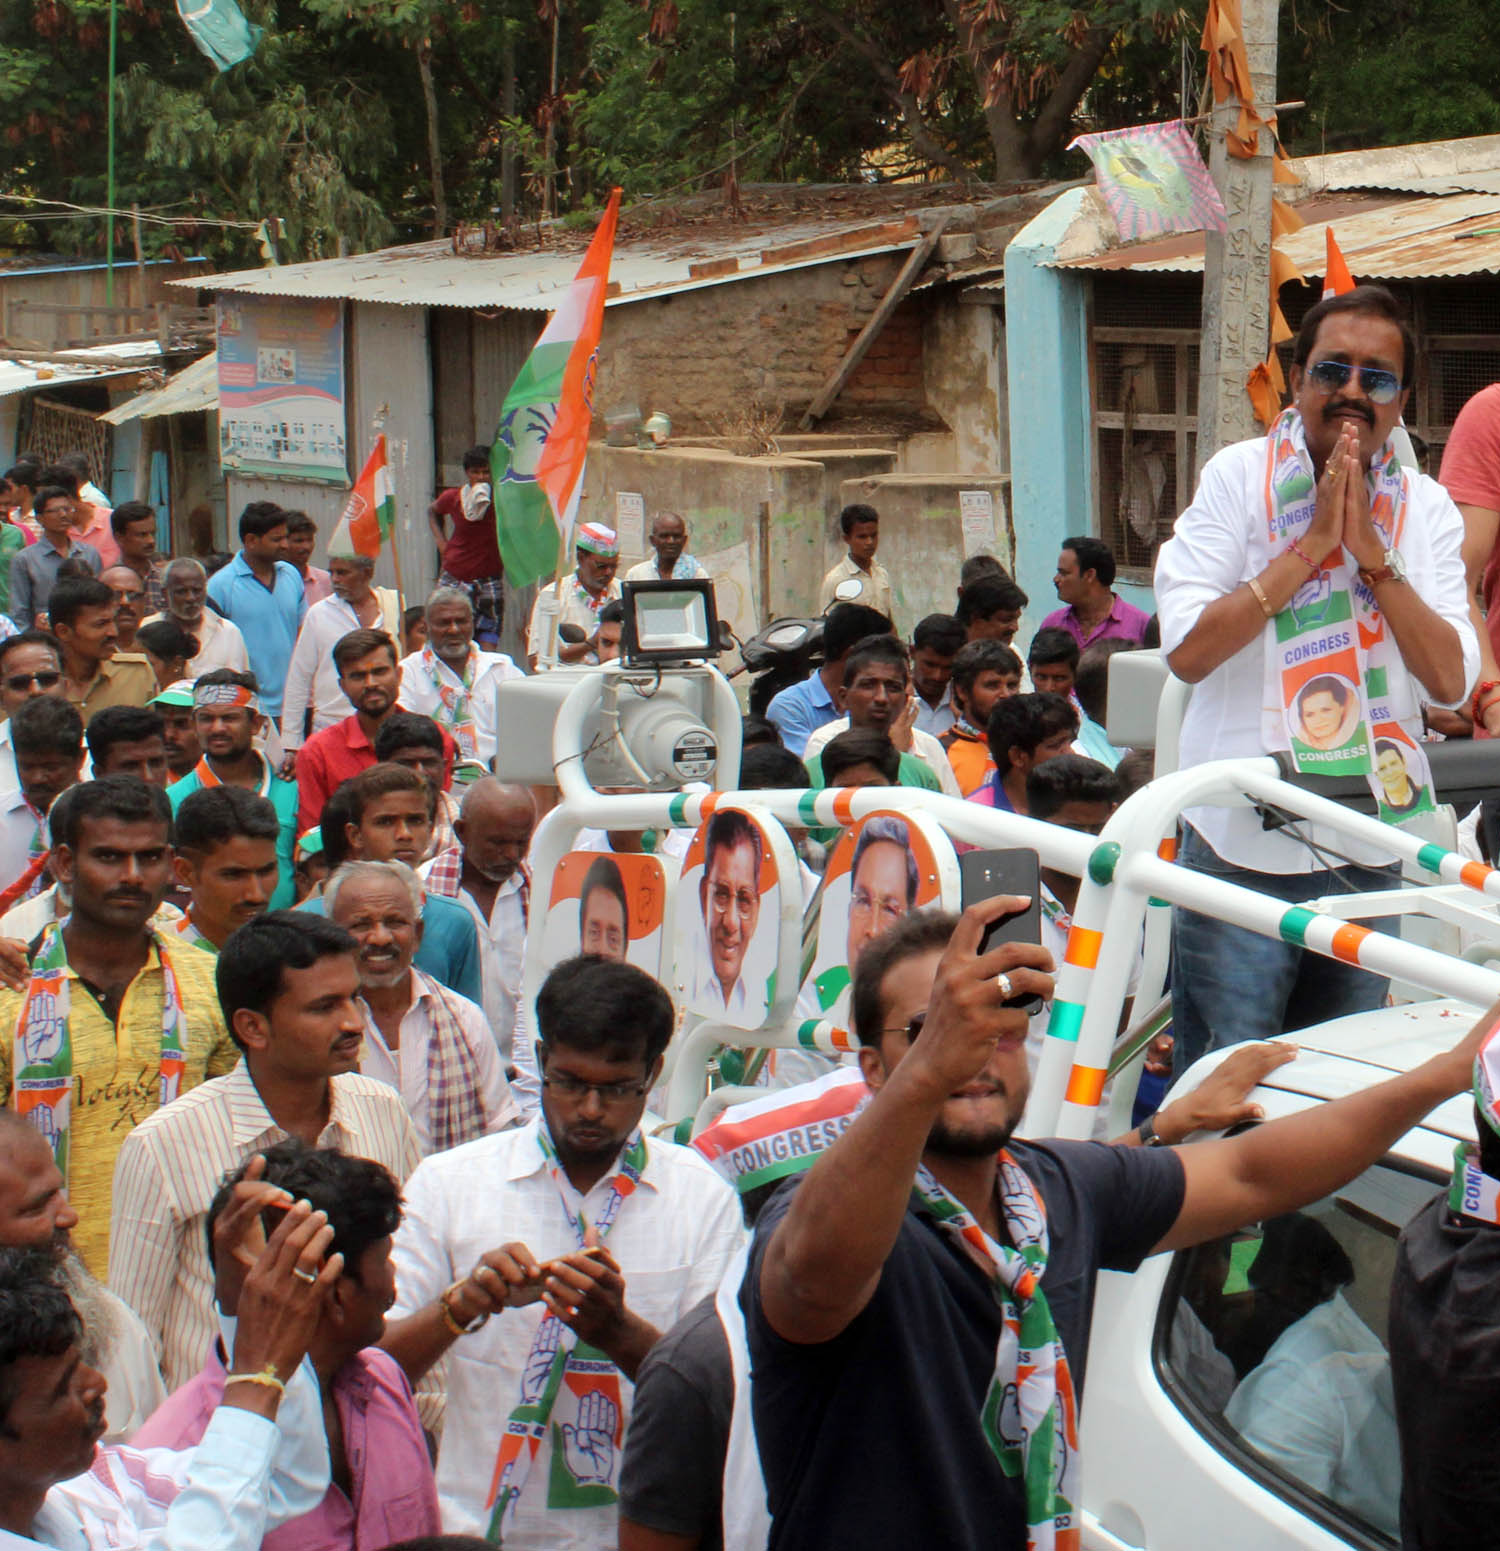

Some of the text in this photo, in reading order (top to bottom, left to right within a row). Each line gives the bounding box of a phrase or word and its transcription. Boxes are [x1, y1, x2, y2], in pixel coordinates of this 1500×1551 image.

[1270, 503, 1316, 532] CONGRE
[1284, 631, 1351, 665] CONGRESS
[1298, 743, 1369, 762] CONGRESS
